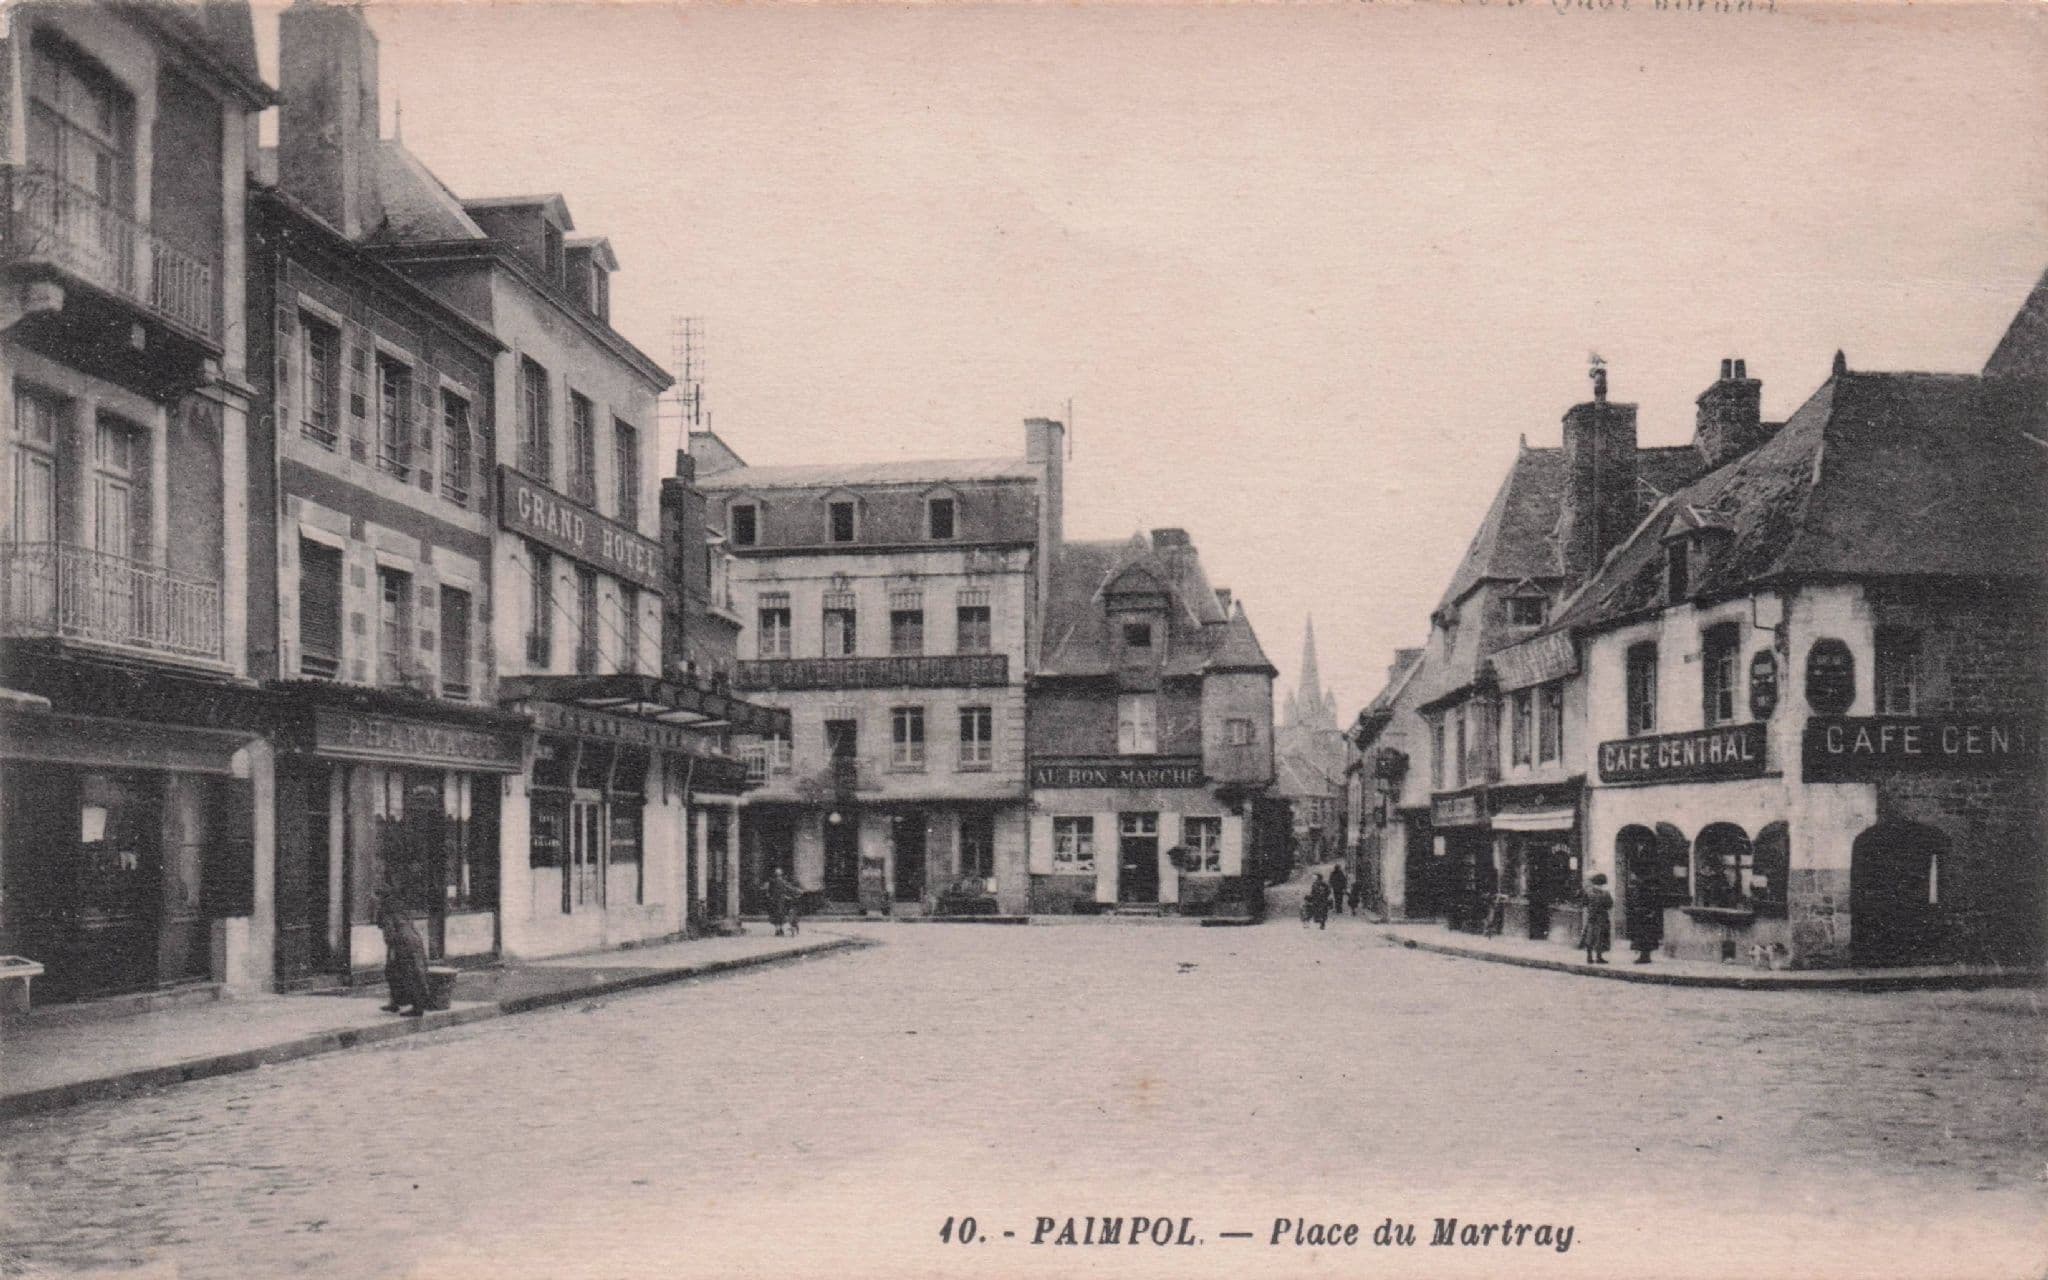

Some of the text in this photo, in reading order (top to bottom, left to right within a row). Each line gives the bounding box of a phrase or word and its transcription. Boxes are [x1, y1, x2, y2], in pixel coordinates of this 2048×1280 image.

[518, 487, 656, 577] GRAND HOTEL
[1604, 733, 1754, 772] CAFE CENTRAL
[1826, 726, 1922, 754] CAFE
[1068, 769, 1107, 784] BON
